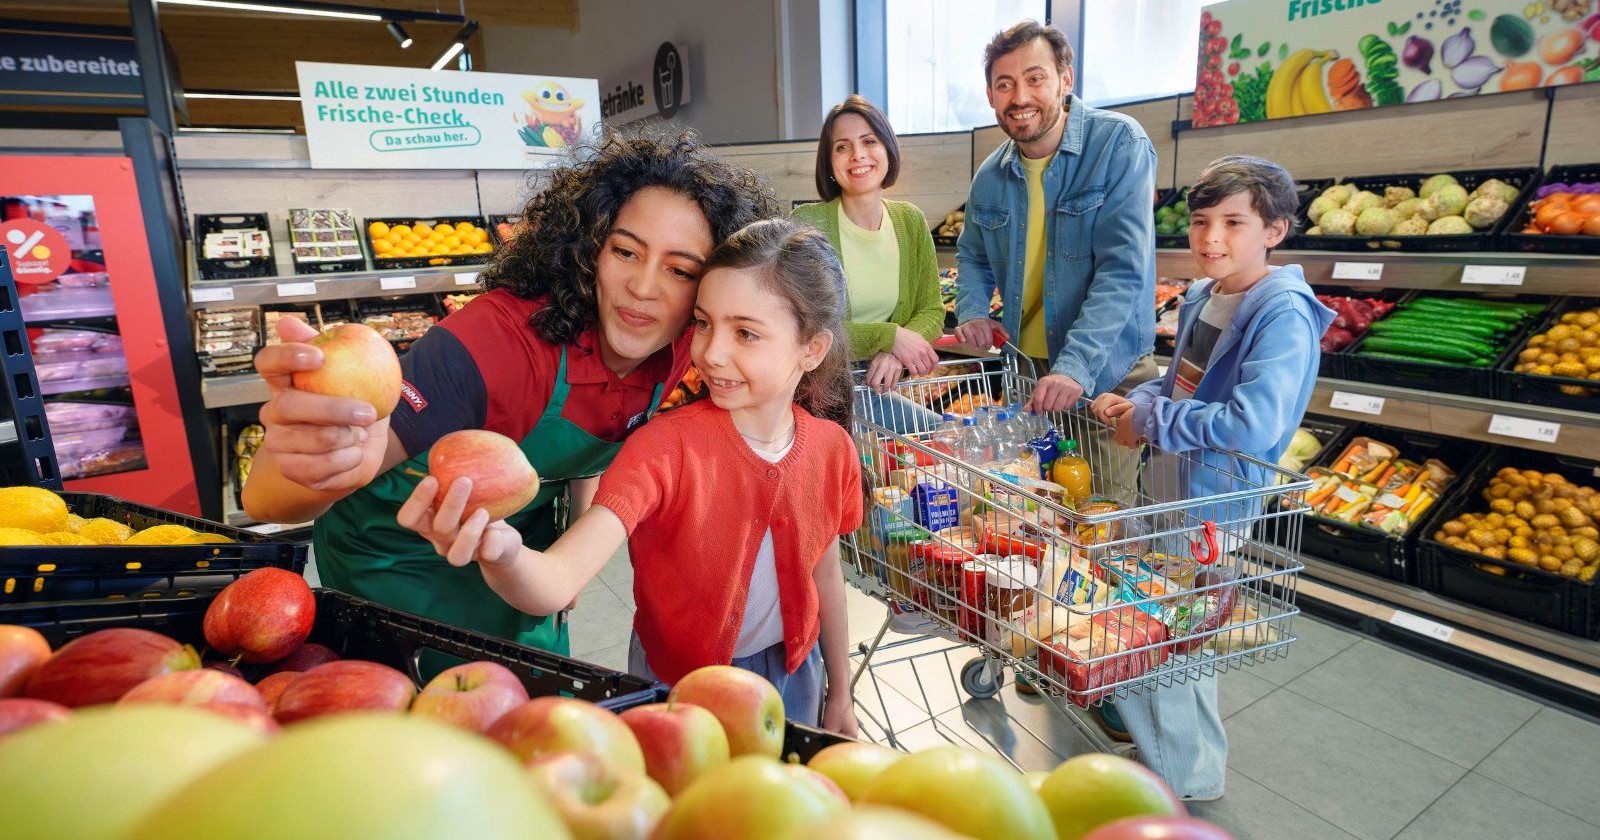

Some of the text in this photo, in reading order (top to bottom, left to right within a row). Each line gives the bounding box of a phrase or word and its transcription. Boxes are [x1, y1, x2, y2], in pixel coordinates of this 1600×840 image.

[1288, 0, 1382, 21] Frisc
[0, 54, 140, 76] e zubereitet
[314, 81, 504, 105] Alle zwei Stunden
[601, 81, 645, 119] etränke
[317, 103, 470, 126] Frische-Check.
[385, 132, 467, 146] Da schau her.
